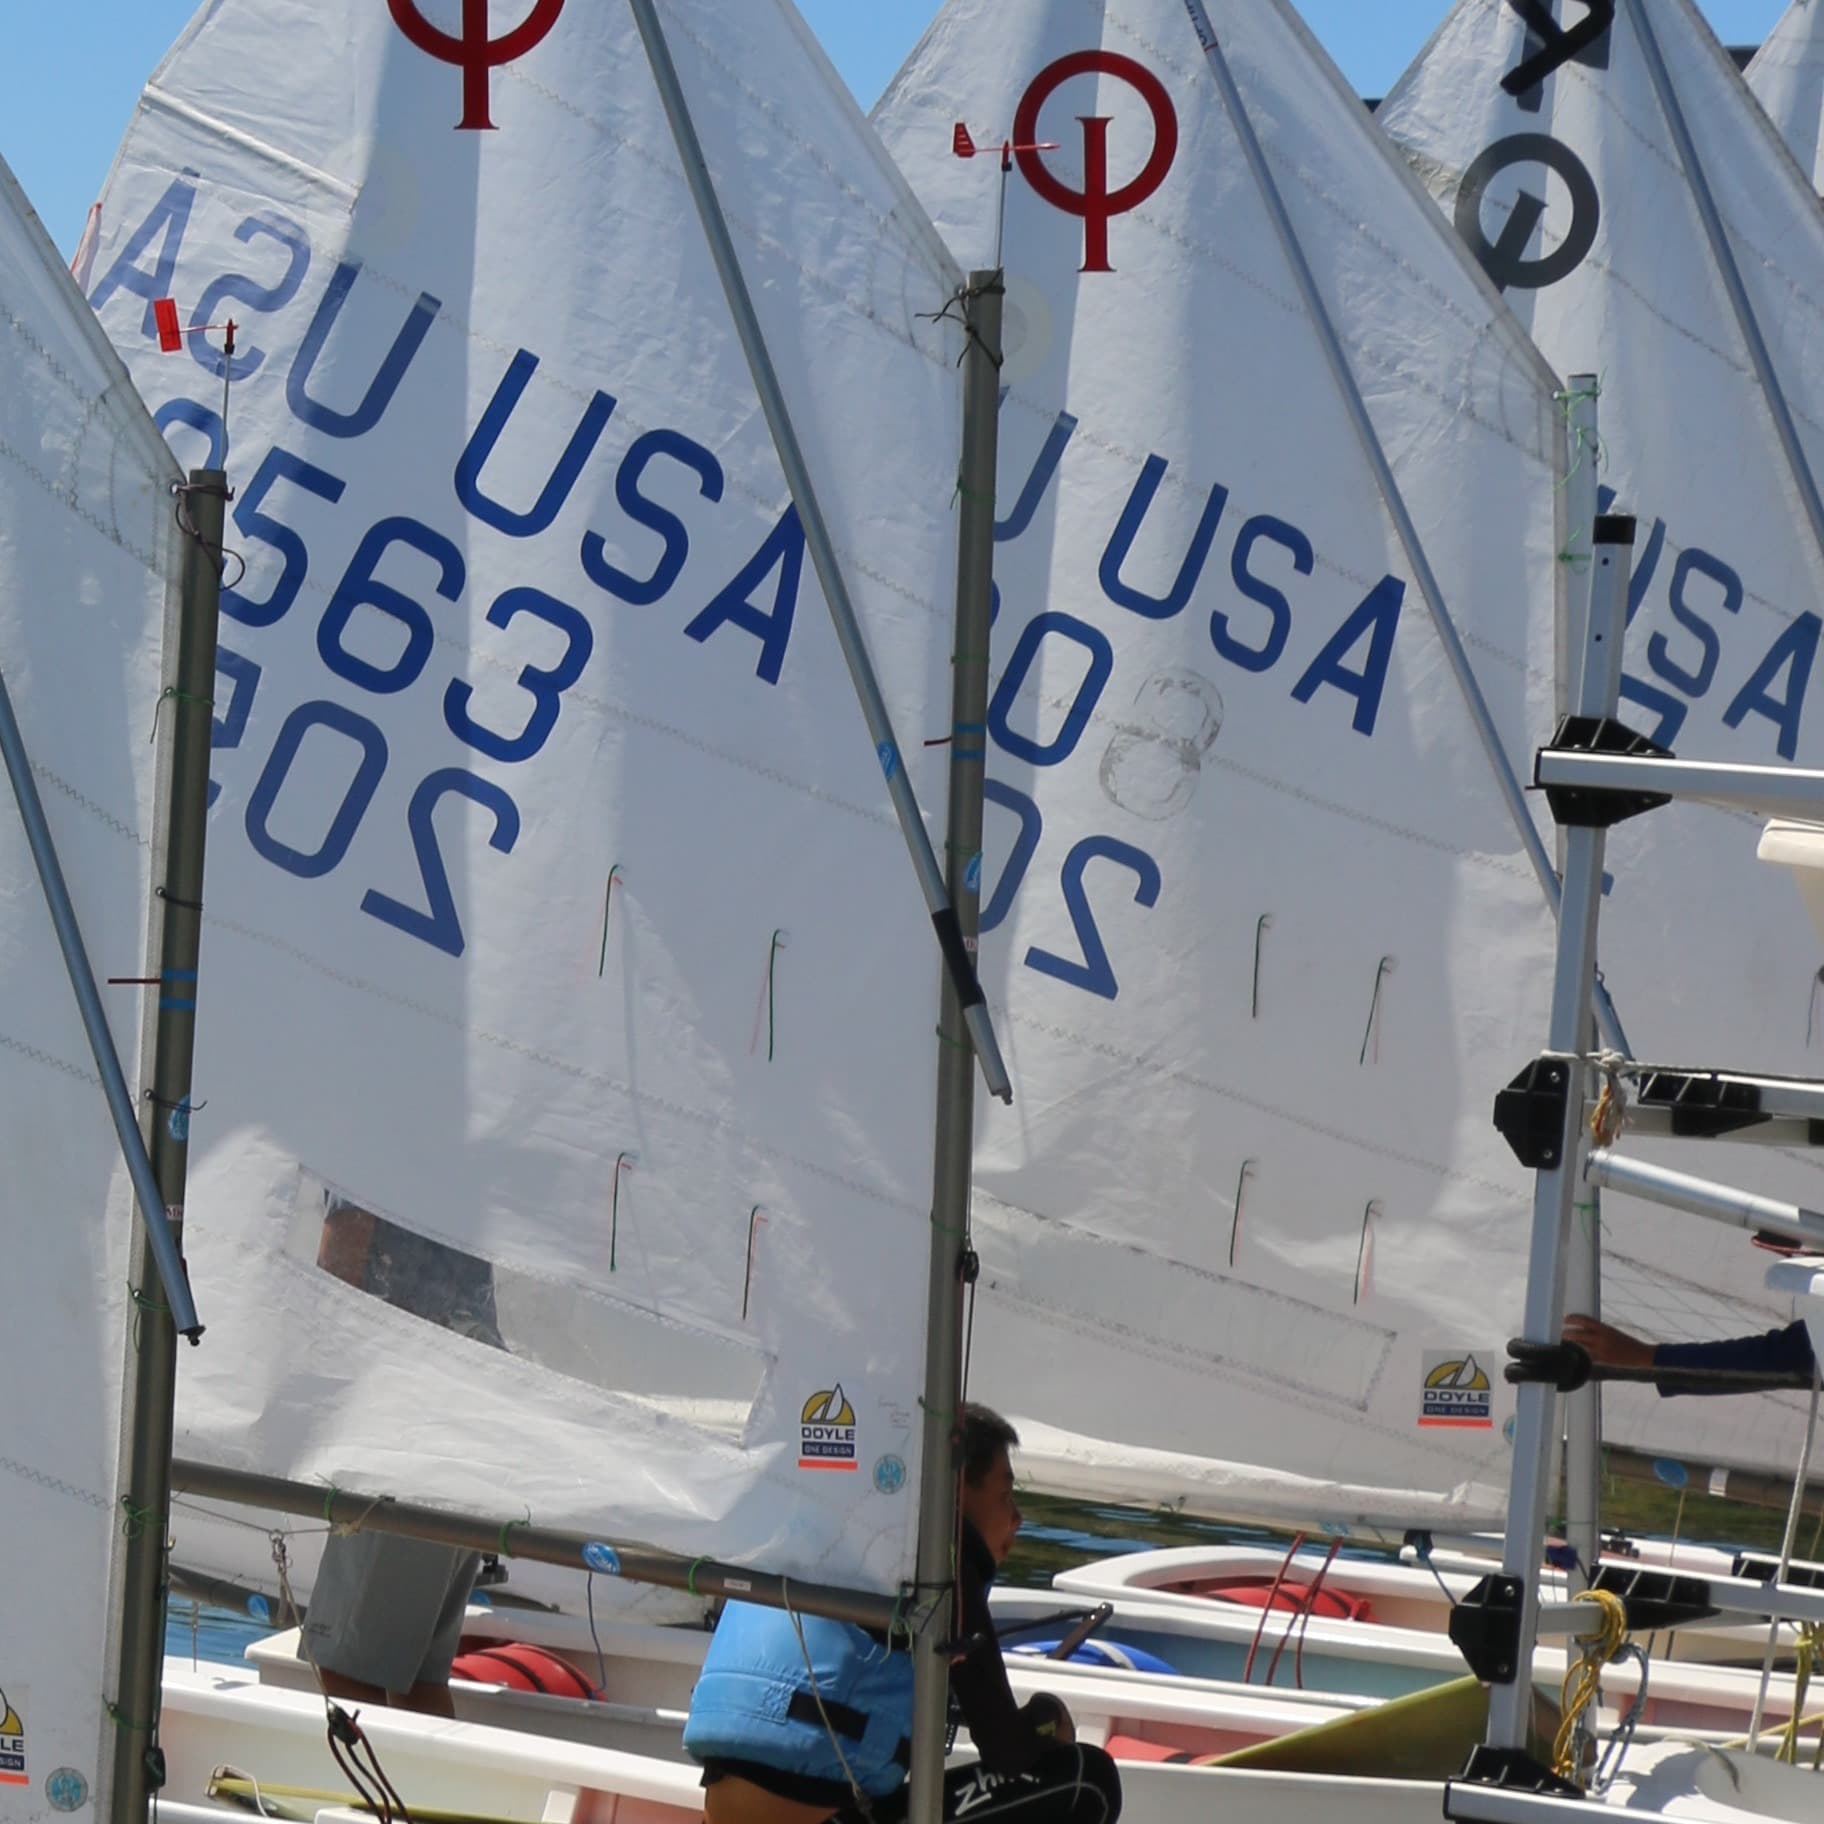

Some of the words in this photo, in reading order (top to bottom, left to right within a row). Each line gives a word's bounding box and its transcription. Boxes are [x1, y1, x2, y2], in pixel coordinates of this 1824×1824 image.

[454, 348, 805, 686] USA
[1099, 454, 1406, 736] USA
[801, 1427, 855, 1441] DOYLE
[1424, 1390, 1489, 1403] DOYLE
